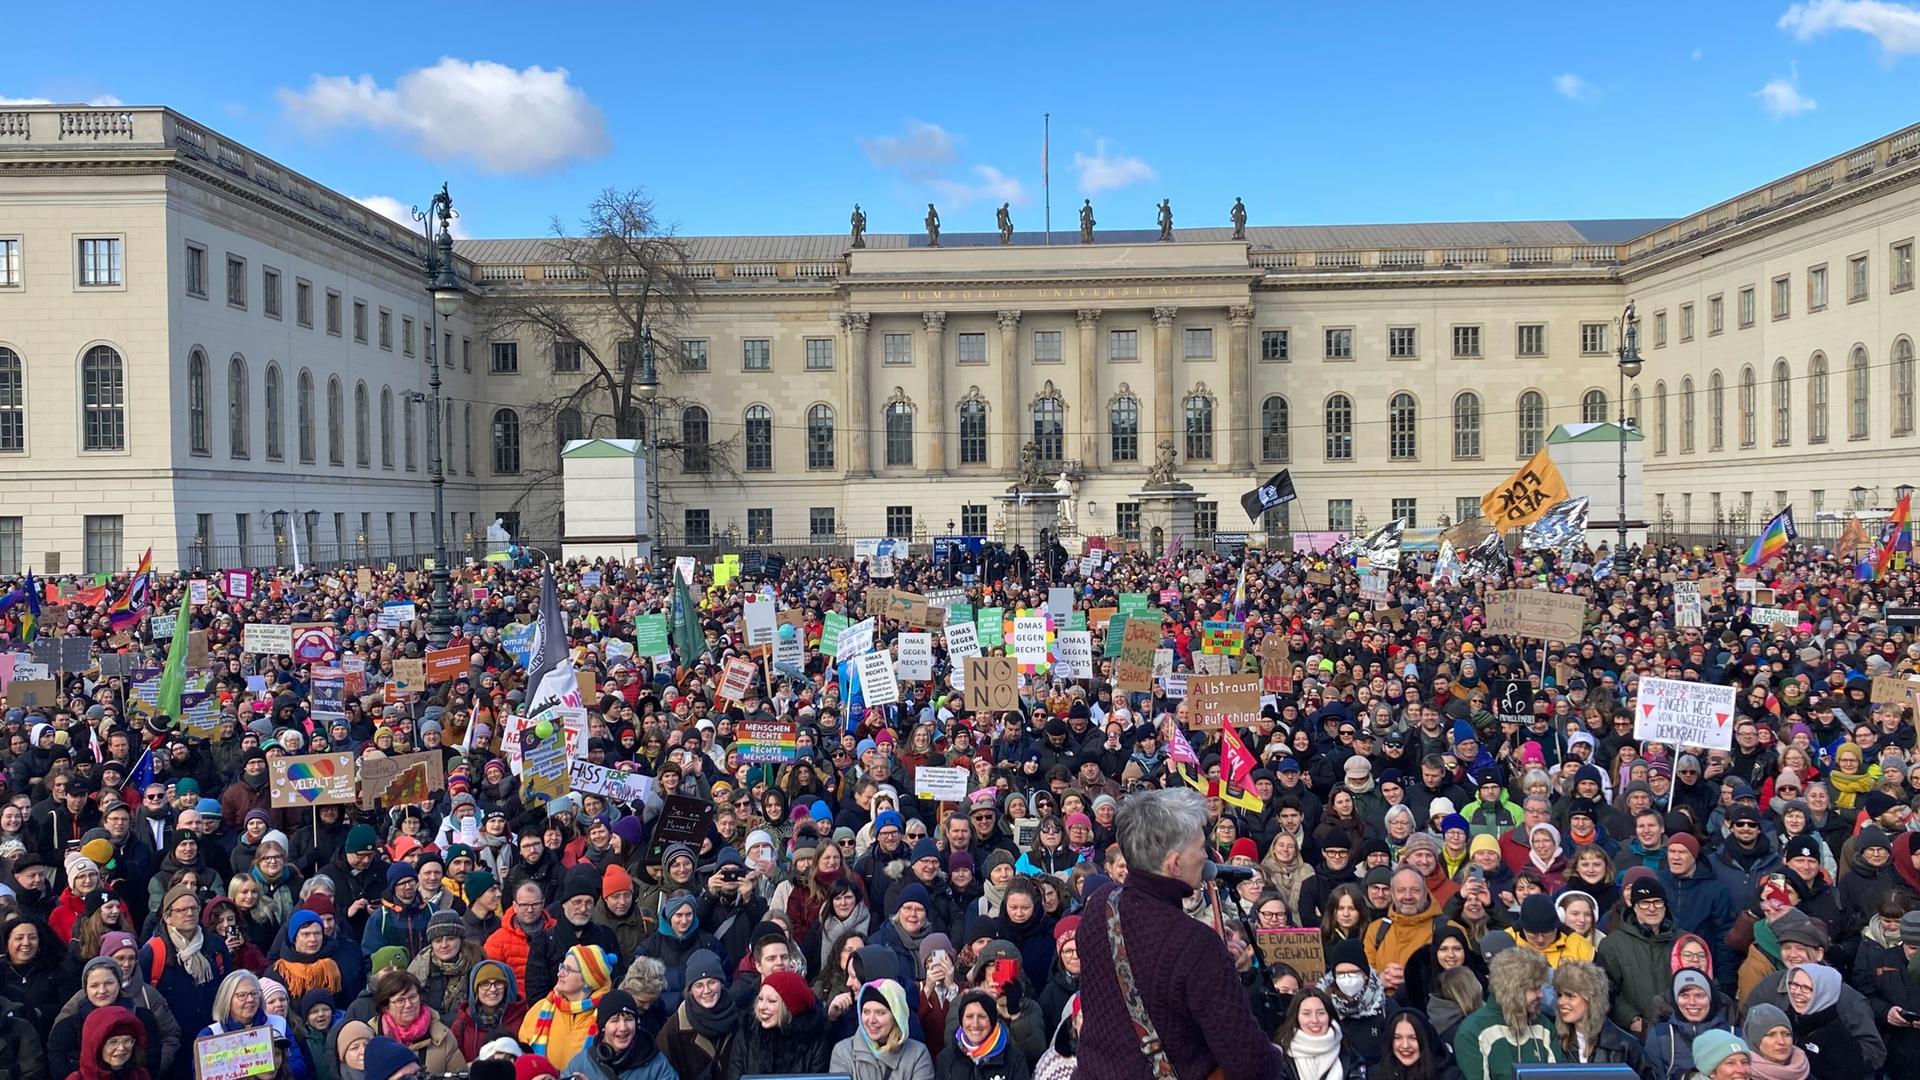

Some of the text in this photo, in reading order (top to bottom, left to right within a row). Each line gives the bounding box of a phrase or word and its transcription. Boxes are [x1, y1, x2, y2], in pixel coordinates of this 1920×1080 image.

[902, 290, 1016, 300] HUMBOLDT
[950, 627, 971, 637] OMAS
[502, 638, 529, 646] omas
[950, 636, 974, 646] GEGEN
[950, 644, 978, 654] RECHTS
[864, 654, 883, 662] OMAS
[866, 660, 885, 669] GEGEN
[866, 667, 888, 676] RECHTS
[1194, 681, 1259, 696] Albtraum
[1656, 688, 1665, 697] X
[1680, 689, 1687, 700] Z
[1195, 699, 1218, 710] für
[1658, 696, 1713, 716] FINGER WEG
[1194, 710, 1262, 726] Deutschland
[1657, 711, 1712, 729] VON UNSERER
[744, 724, 790, 732] MENSCHEN
[751, 732, 783, 740] RECHTE
[1656, 724, 1709, 744] DEMOKRATIE
[750, 746, 782, 754] RECHTE
[743, 753, 788, 762] MENSCHEN
[569, 761, 602, 784] HASS
